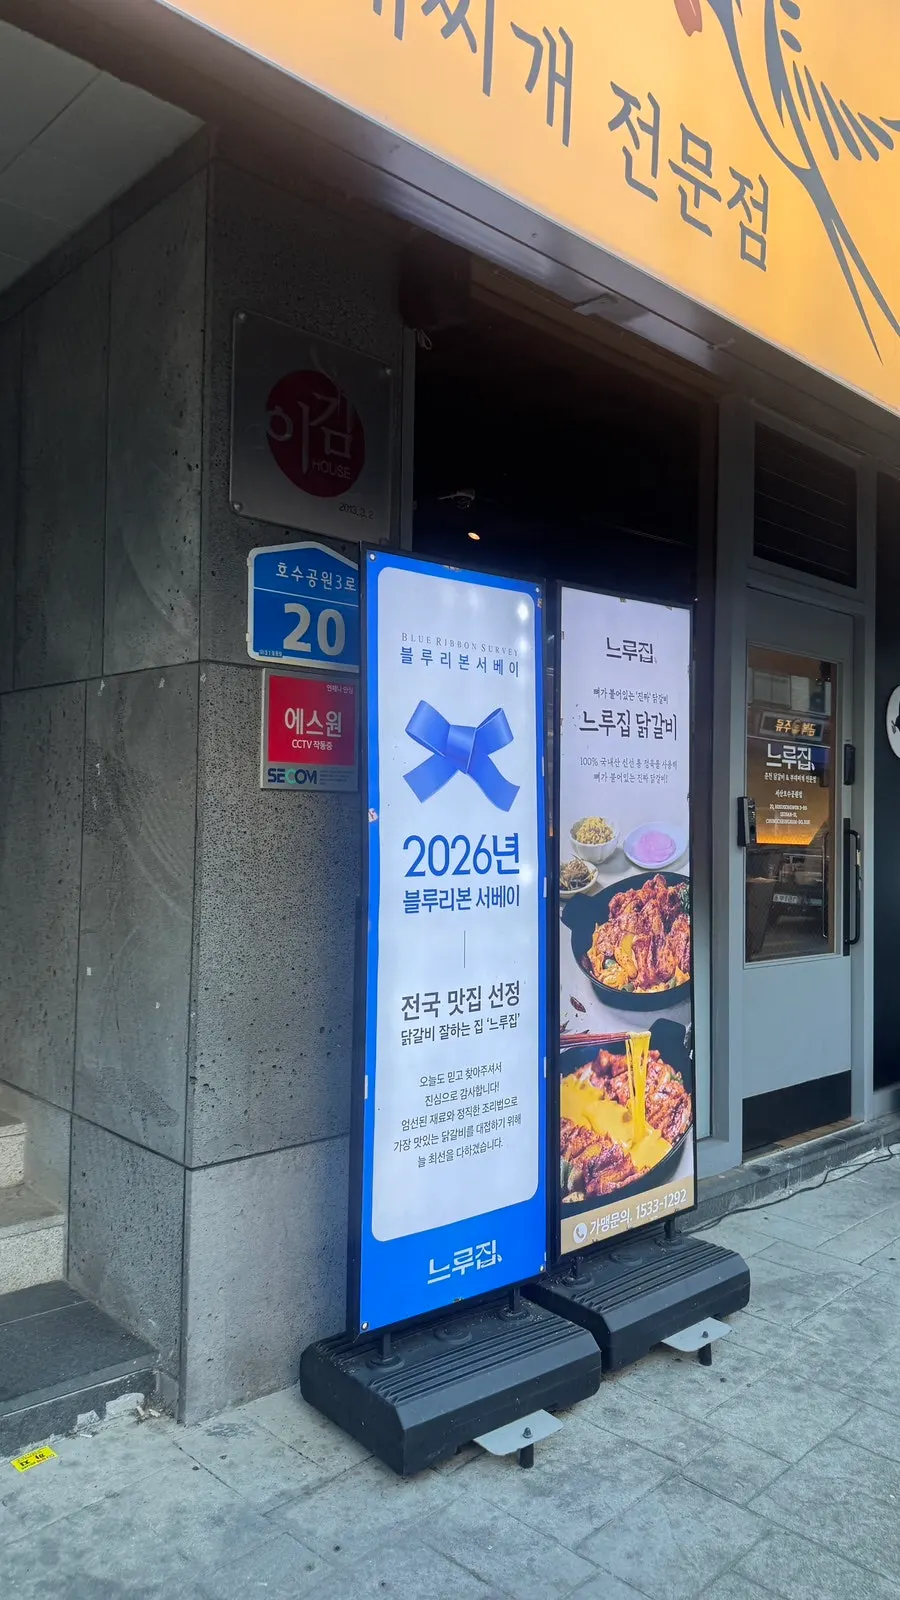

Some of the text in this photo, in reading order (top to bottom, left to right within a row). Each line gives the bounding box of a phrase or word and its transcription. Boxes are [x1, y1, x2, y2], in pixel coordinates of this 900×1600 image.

[373, 0, 770, 272] 찌개 전문점
[312, 459, 353, 480] HOUSE
[276, 562, 356, 591] 호수공원3로
[283, 603, 346, 656] 20
[401, 632, 519, 657] BLUE RIBBON SURVEY
[606, 637, 654, 664] 느루집
[284, 707, 342, 738] 에스원
[579, 709, 677, 741] 느루집 닭갈비
[291, 739, 333, 751] CCTV 작동중
[766, 743, 812, 771] 느루집
[268, 768, 317, 784] SECOM
[580, 757, 598, 767] 100%
[600, 757, 620, 768] 국내산
[402, 832, 520, 877] 2026년
[402, 884, 520, 914] 블루리본 서베이
[401, 980, 520, 1021] 전국 맛집 선정
[401, 1026, 435, 1046] 닭갈비
[439, 1022, 471, 1040] 잘하는
[474, 1019, 483, 1034] 집
[419, 1061, 502, 1087] 오늘도 믿고 찾아주셔서
[424, 1081, 500, 1107] 진심으로 감사합니다!
[401, 1096, 518, 1132] 엄선된 재료와 정직한 조리법으로
[393, 1113, 521, 1153] 가장 맛있는 닭갈비를 대접하기 위해
[417, 1137, 503, 1168] 늘 최선을 다하겠습니다.
[590, 1189, 687, 1235] 가맹문의. 1533-1292
[427, 1240, 499, 1284] 느루집
